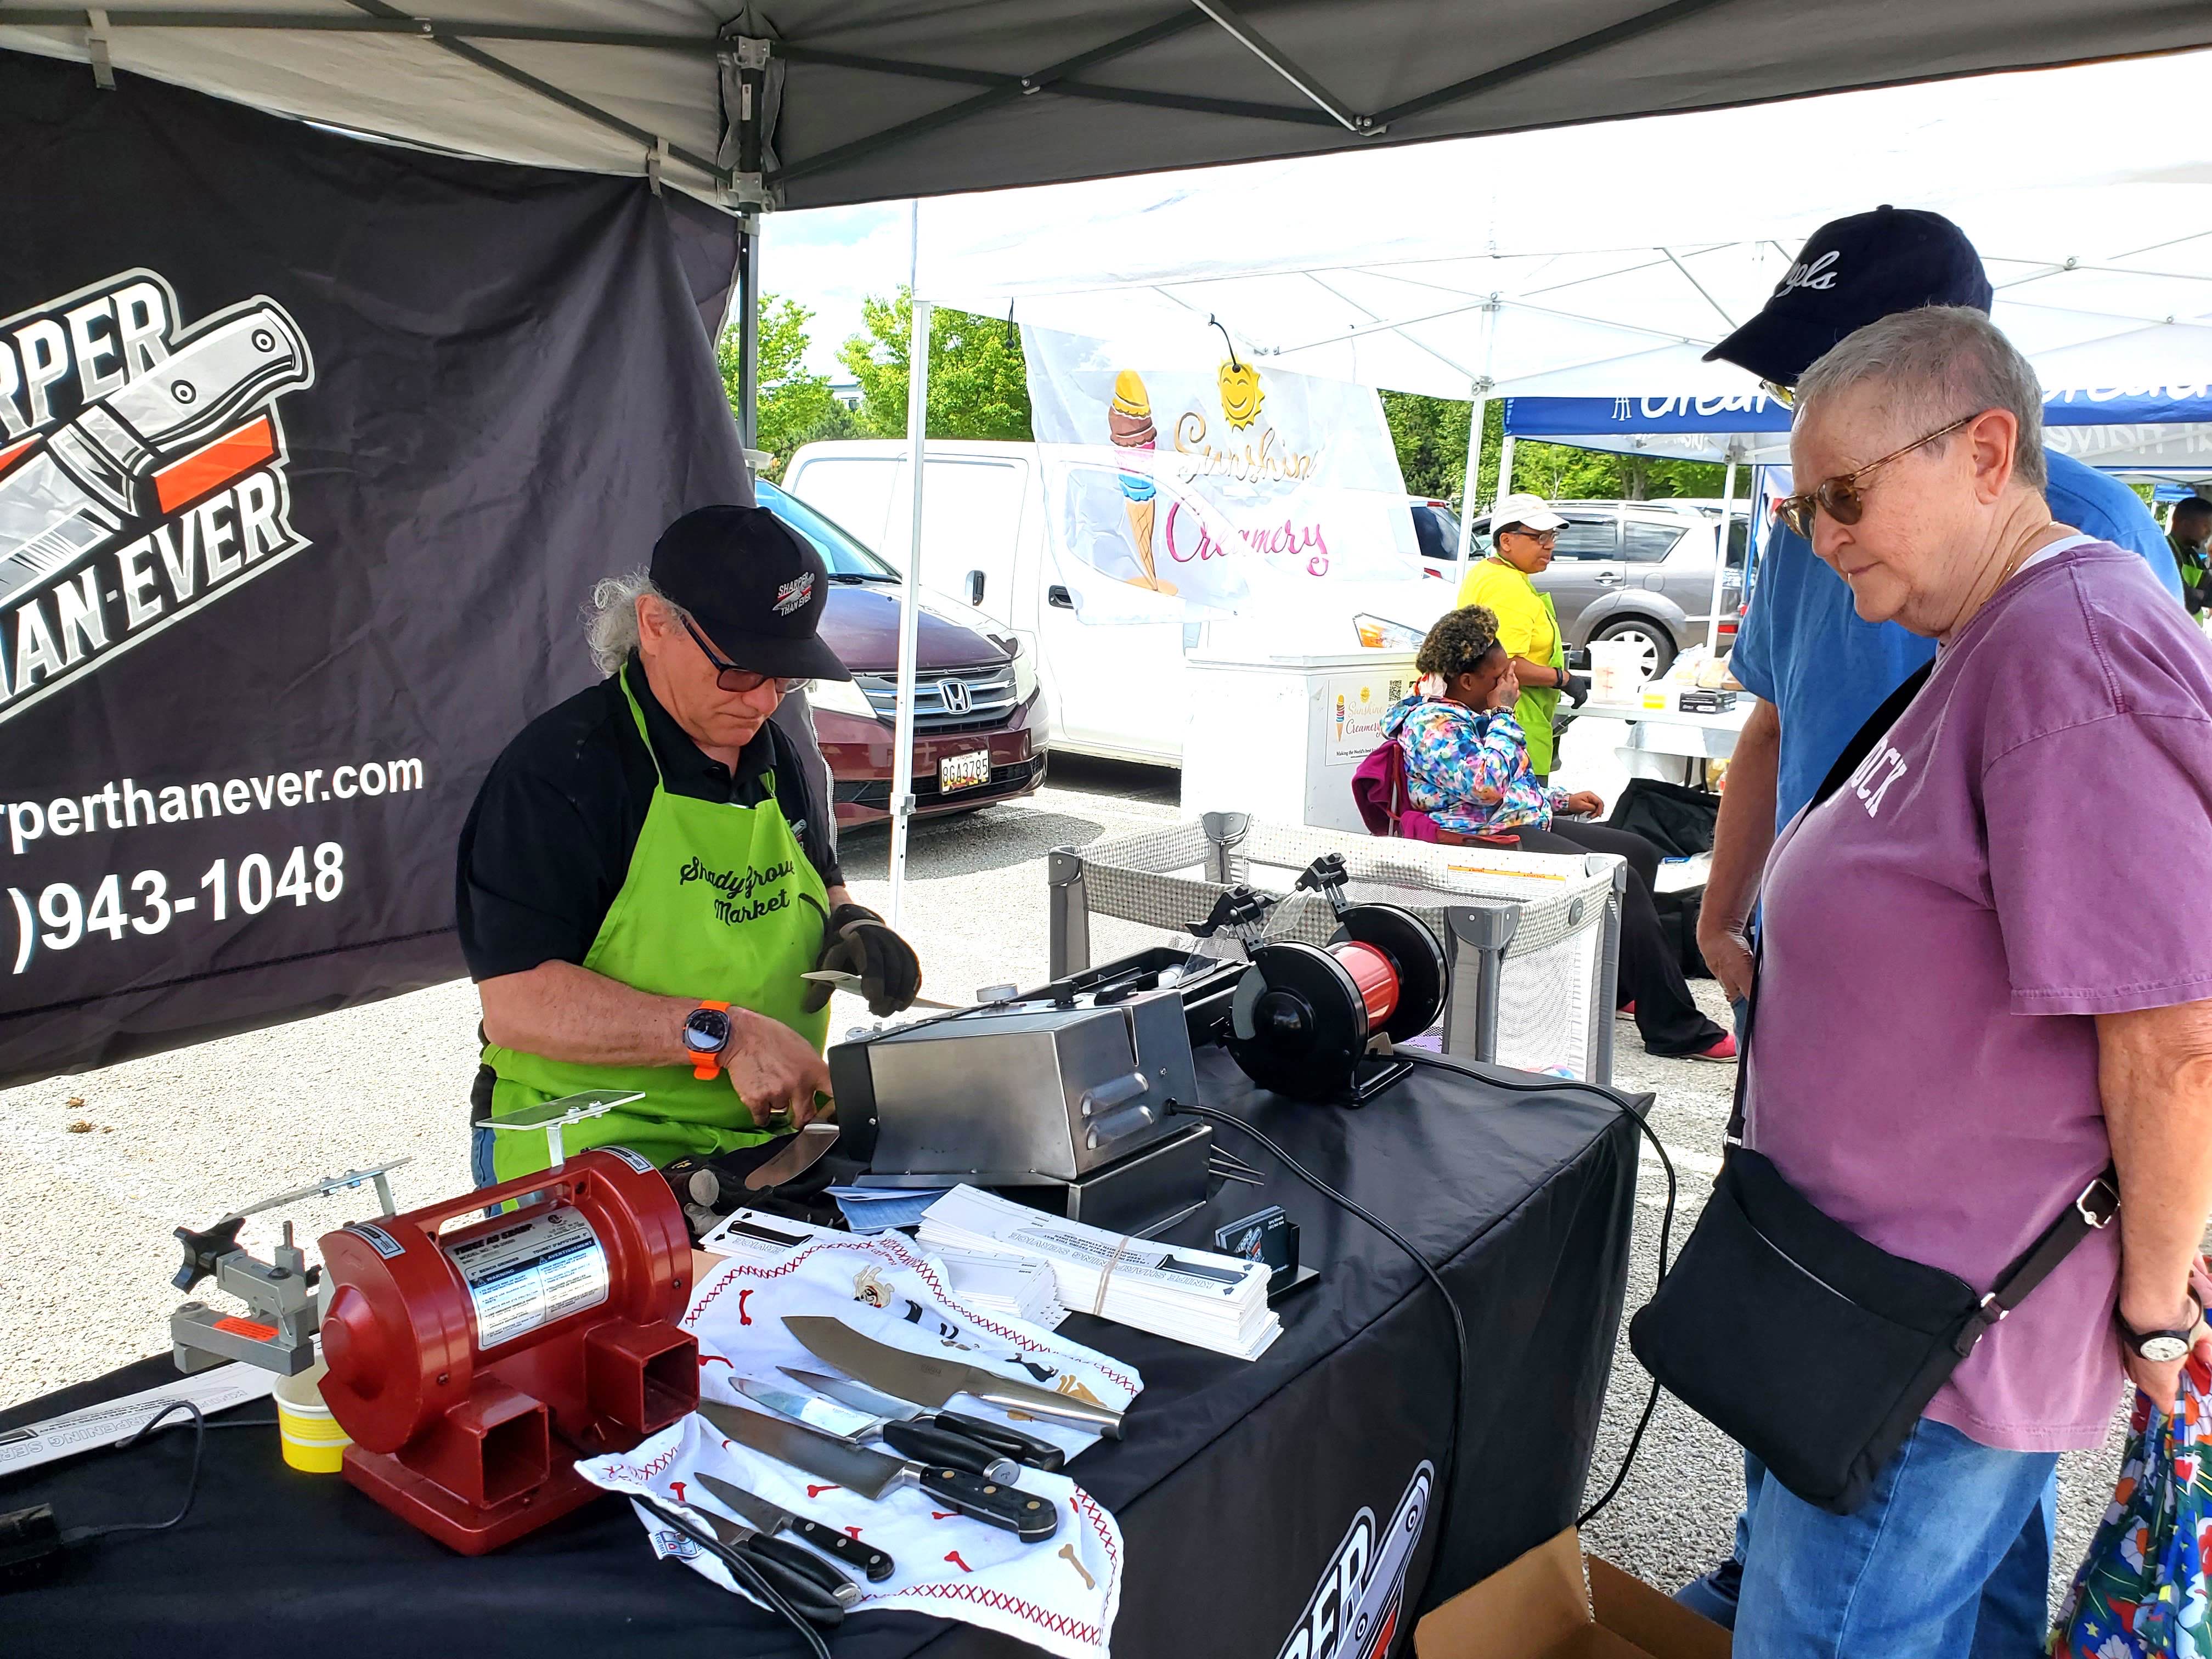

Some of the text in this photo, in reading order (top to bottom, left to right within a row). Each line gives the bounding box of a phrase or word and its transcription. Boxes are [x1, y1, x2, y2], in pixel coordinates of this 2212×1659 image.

[1174, 412, 1325, 483] Sunshin
[0, 472, 287, 699] AN-EVER
[715, 889, 790, 927] Market
[733, 1237, 785, 1254] ERVICE
[1008, 1232, 1214, 1289] KNIFE SHARPNING SERVICE
[486, 1269, 515, 1281] WARNING
[199, 1390, 248, 1409] KNIF
[48, 1408, 185, 1447] SARPENING
